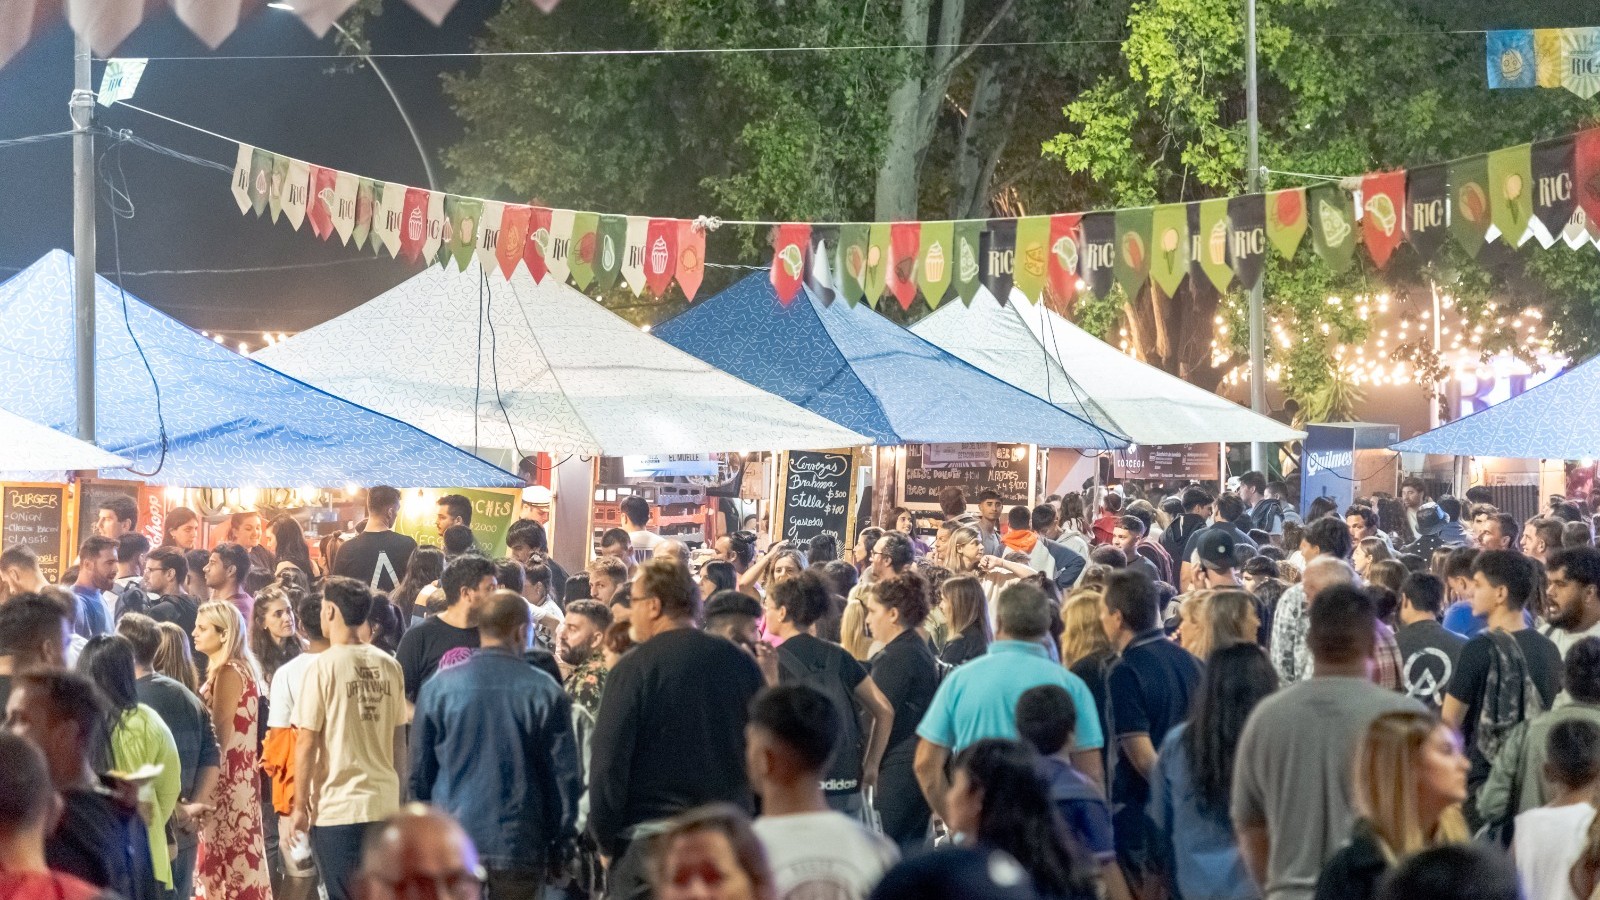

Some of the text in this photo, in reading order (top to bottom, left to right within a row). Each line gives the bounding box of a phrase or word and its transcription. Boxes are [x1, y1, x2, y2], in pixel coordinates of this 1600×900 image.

[795, 456, 838, 477] Cervezas
[1307, 451, 1353, 476] Quilmes
[789, 474, 838, 490] Brahma
[9, 490, 58, 508] BURGER
[789, 491, 825, 508] Stella
[825, 488, 847, 501] $500
[824, 503, 845, 516] $700
[470, 522, 497, 533] 2000
